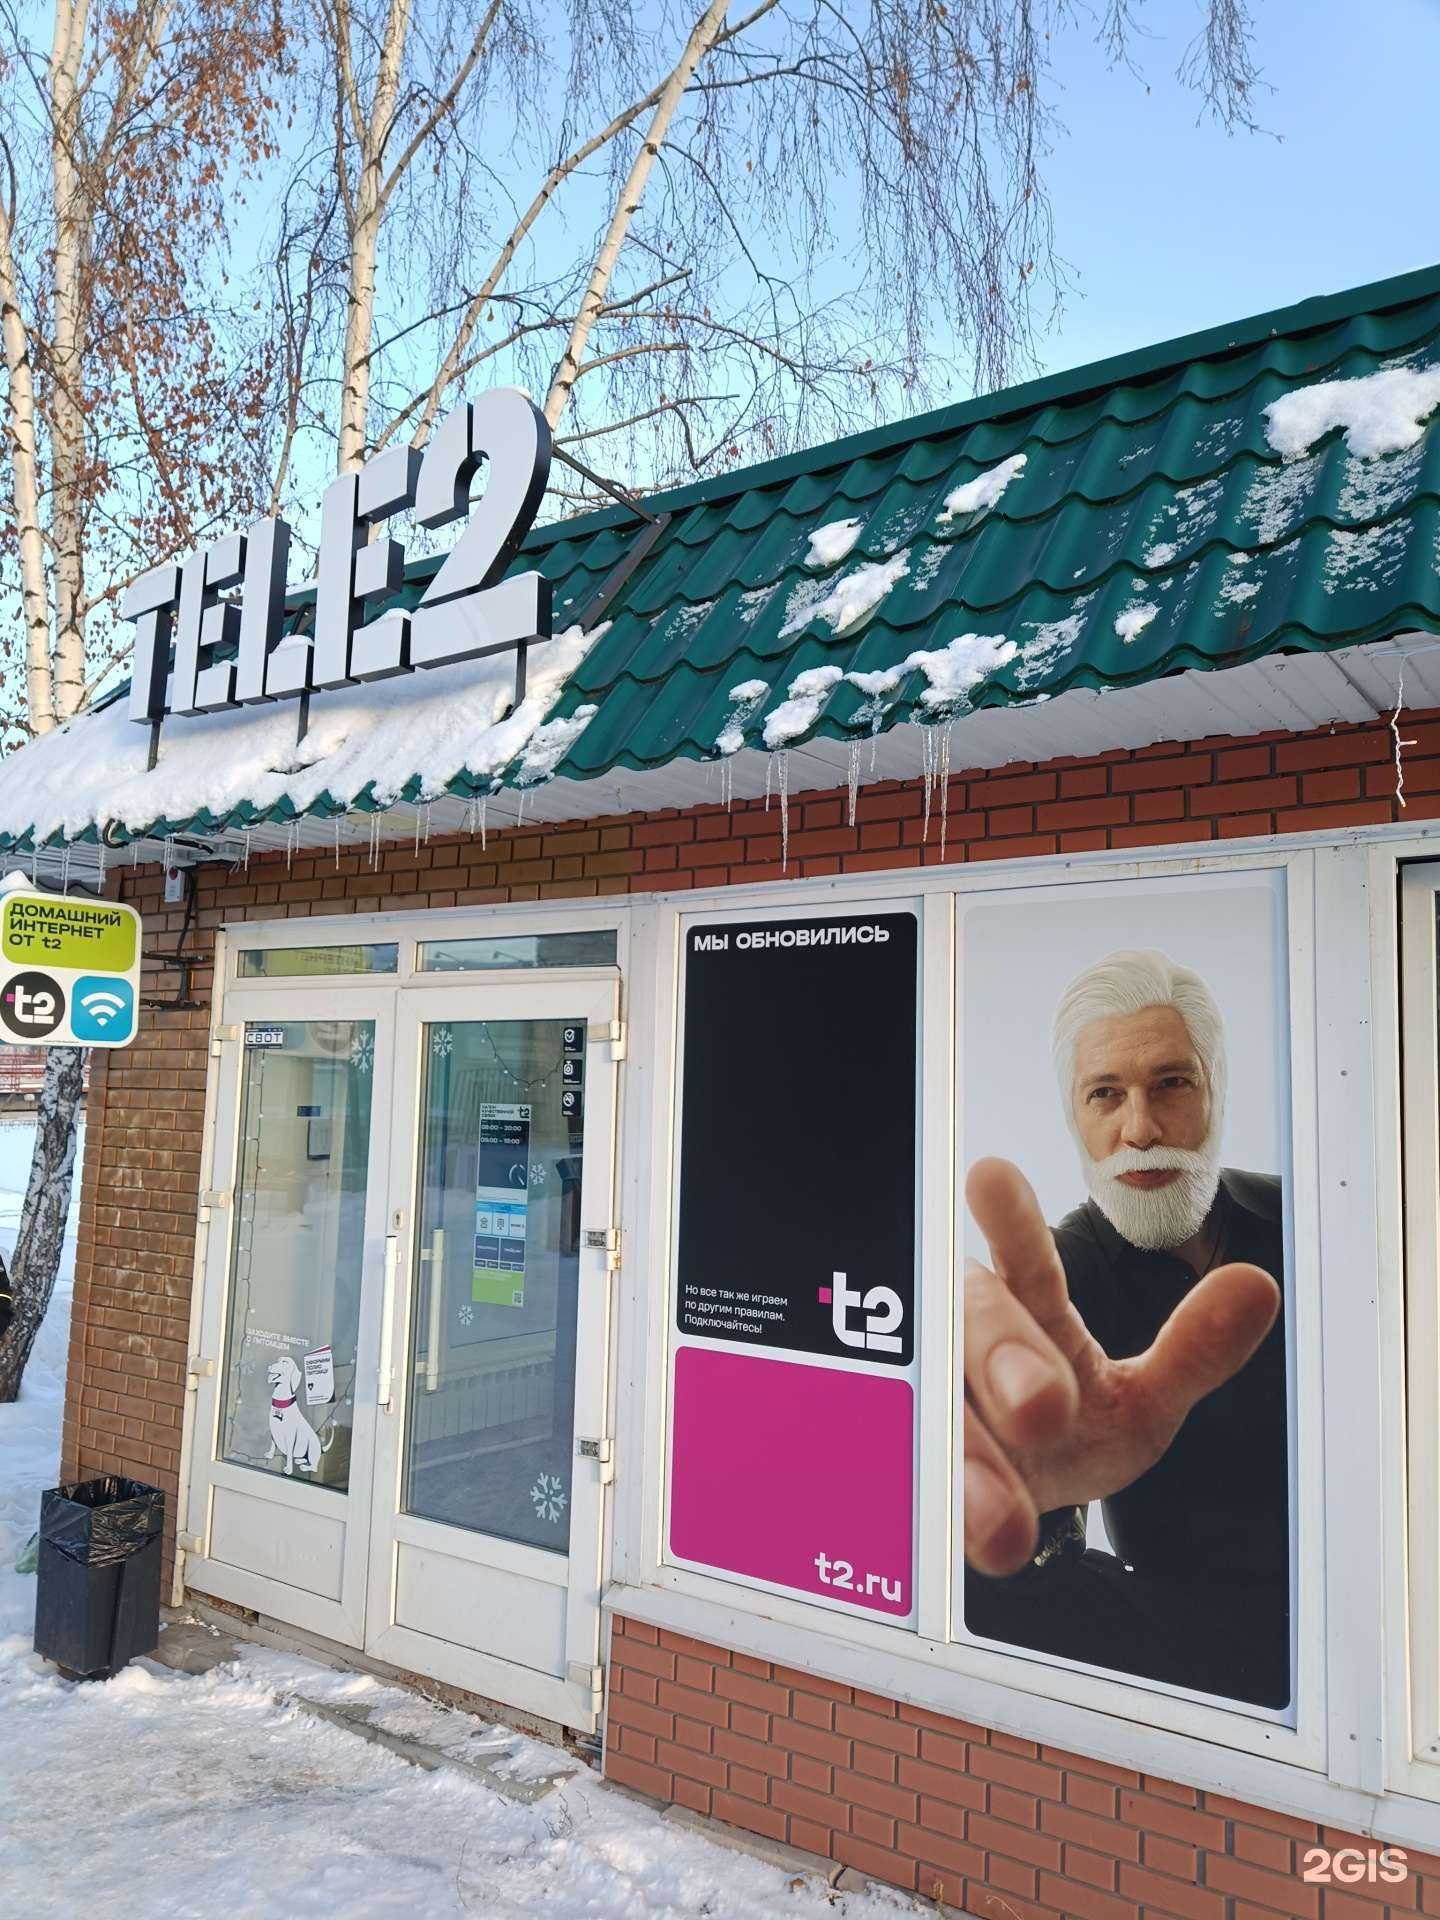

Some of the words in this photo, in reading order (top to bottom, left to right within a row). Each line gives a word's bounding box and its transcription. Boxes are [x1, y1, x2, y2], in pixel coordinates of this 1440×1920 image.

[122, 386, 552, 725] TELE2
[10, 902, 121, 927] ДОМАШНИЙ
[10, 918, 105, 939] ИНТЕРНЕТ
[694, 934, 729, 951] МЫ
[735, 925, 890, 950] ОБНОВИЛИСЬ
[9, 933, 35, 947] ОТ
[42, 936, 62, 950] t2
[13, 985, 56, 1025] t2
[685, 1284, 698, 1295] Но
[700, 1287, 717, 1297] все
[719, 1290, 735, 1300] так
[736, 1292, 750, 1302] же
[751, 1294, 788, 1306] играем
[685, 1300, 697, 1310] по
[698, 1302, 732, 1314] другим
[734, 1306, 786, 1321] правилам.
[832, 1271, 904, 1354] t2
[684, 1313, 762, 1334] Подключайтесь!
[814, 1551, 902, 1603] t2.ru
